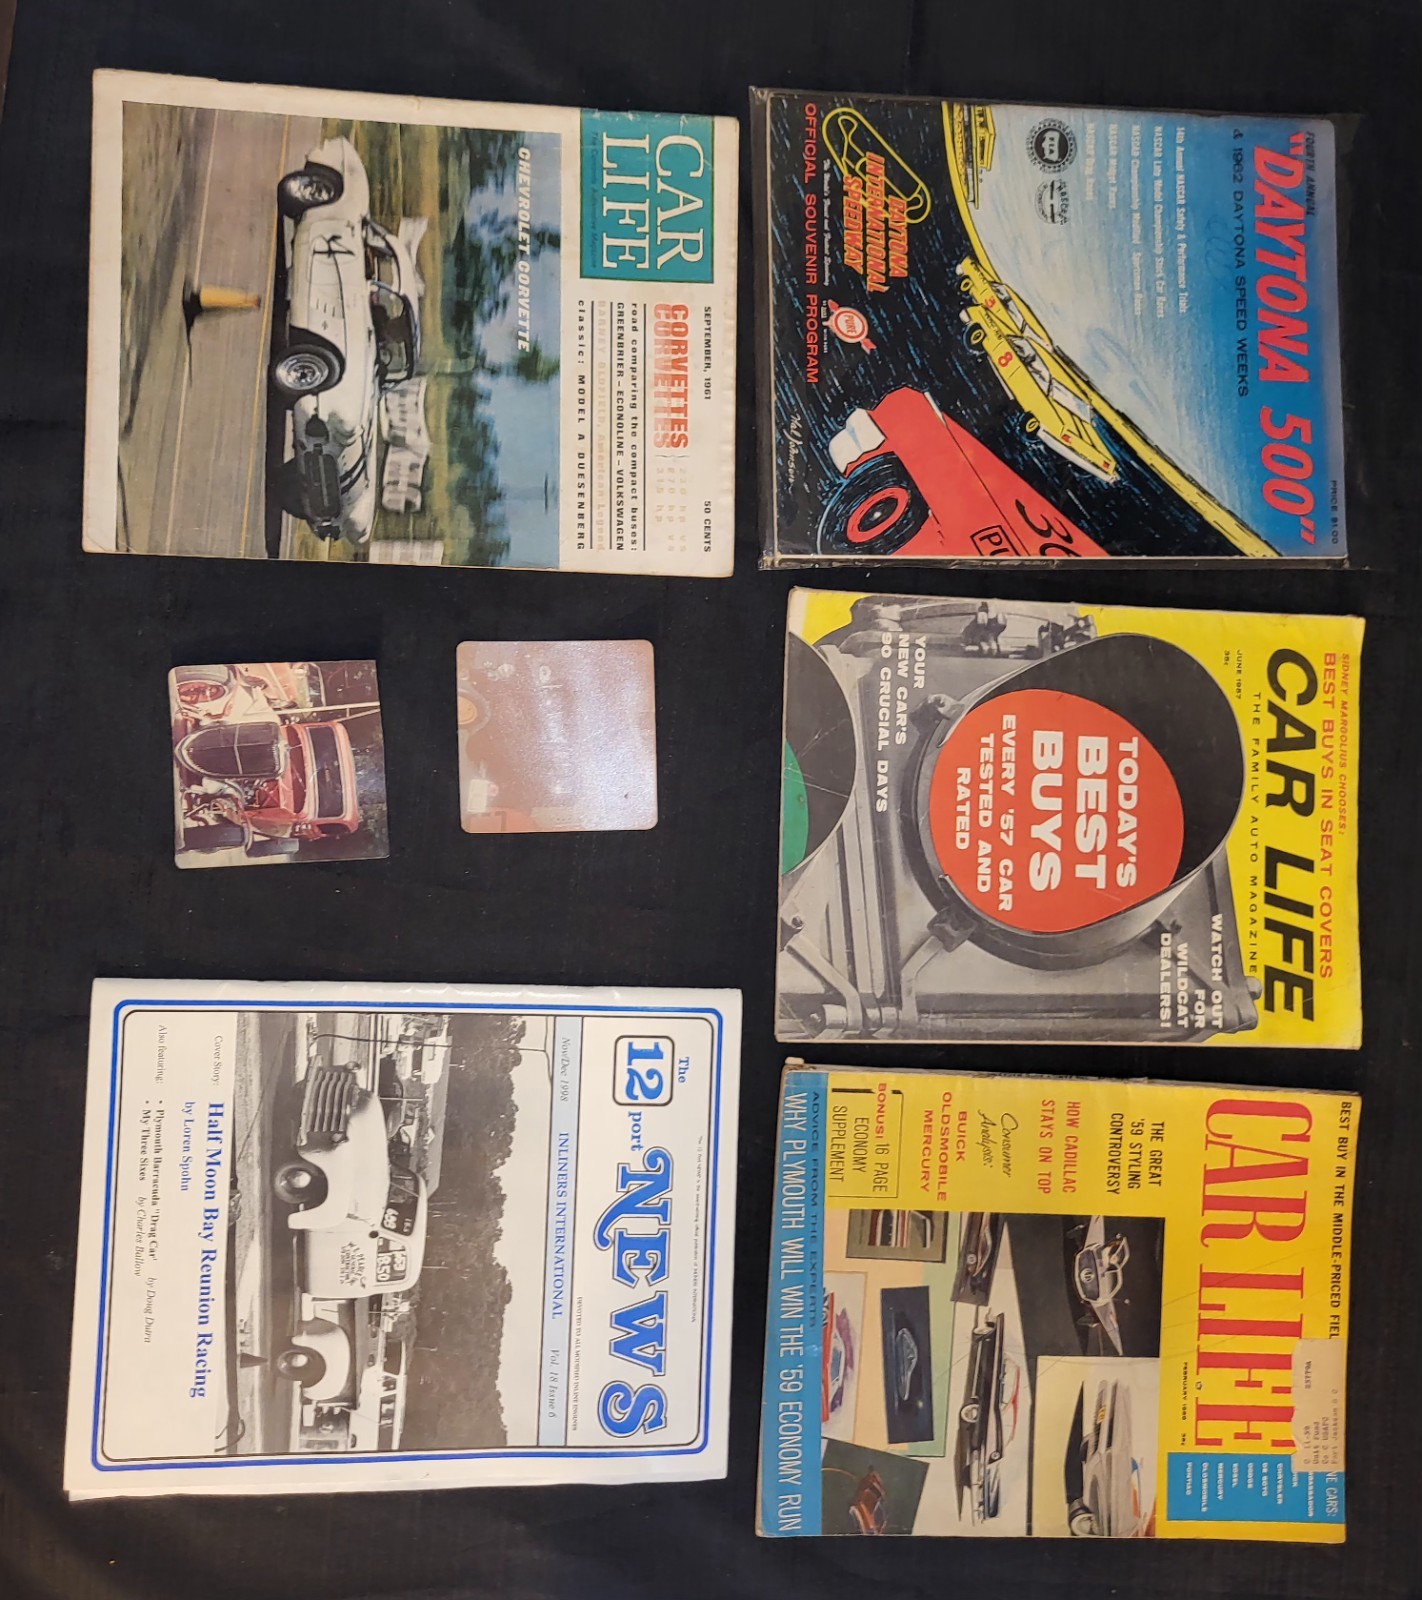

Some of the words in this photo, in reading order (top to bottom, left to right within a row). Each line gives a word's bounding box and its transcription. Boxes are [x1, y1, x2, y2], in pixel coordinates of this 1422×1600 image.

[804, 103, 818, 184] OFFICIAL
[1176, 126, 1185, 143] 14th
[1233, 128, 1243, 140] &
[1304, 132, 1316, 171] FOURTH
[1176, 146, 1185, 171] Annual
[1232, 147, 1244, 184] 1962
[517, 148, 530, 254] CHEVROLET
[602, 132, 650, 268] LIFE
[656, 134, 704, 268] CAR
[1176, 174, 1186, 204] NASCAR
[1306, 176, 1316, 216] ANNUAL
[804, 194, 818, 285] SOUVENIR
[842, 175, 864, 274] SPEEDWAY
[866, 152, 889, 292] INTERNATIONAL
[887, 195, 908, 278] DAYTONA
[1175, 208, 1186, 230] Safety
[1233, 190, 1246, 270] DAYTONA
[1177, 243, 1187, 288] Performance
[1253, 132, 1309, 382] "DAYTONA
[516, 260, 530, 352] CORVETTE
[630, 303, 638, 332] road
[844, 314, 856, 335] PURE
[1234, 276, 1247, 331] SPEED
[578, 300, 586, 364] classic:
[616, 302, 624, 378] GREENBRIER
[703, 306, 712, 372] SEPTEMBER,
[805, 294, 819, 384] PROGRAM
[629, 340, 638, 410] comparing
[670, 304, 689, 449] CORVETTES
[998, 351, 1014, 368] 8
[1236, 338, 1248, 398] WEEKS
[578, 375, 586, 423] MODEL
[704, 378, 712, 400] 1961
[616, 390, 624, 456] ECONOLINE
[630, 416, 638, 437] the
[630, 444, 638, 500] compact
[1260, 406, 1316, 545] 500"
[577, 452, 586, 550] DUESENBERG
[616, 469, 624, 550] VOLKSWAGEN
[704, 501, 712, 514] 50
[630, 508, 639, 552] buses:
[704, 518, 712, 552] CENTS
[880, 632, 893, 658] 90
[896, 634, 910, 677] NEW
[912, 636, 926, 689] YOUR
[1322, 652, 1336, 710] BEST
[1340, 653, 1350, 696] SIDNEY
[877, 667, 892, 751] CRUCIAL
[895, 686, 910, 745] CAR'S
[1252, 692, 1262, 725] THE
[1000, 714, 1016, 796] EVERY
[1265, 648, 1319, 818] CAR
[1320, 719, 1335, 779] BUYS
[1338, 700, 1348, 768] MARGOLIUS
[876, 760, 890, 812] DAYS
[978, 733, 995, 828] TESTED
[1250, 737, 1260, 804] FAMILY
[955, 766, 971, 850] RATED
[1029, 729, 1064, 892] BUYS
[1076, 734, 1109, 890] BEST
[1116, 736, 1140, 888] TODAY'S
[1320, 788, 1334, 808] IN
[1338, 774, 1347, 836] CHOOSES:
[1000, 808, 1015, 846] '57
[1250, 815, 1259, 864] AUTO
[1320, 819, 1334, 876] SEAT
[977, 840, 994, 892] AND
[998, 858, 1014, 912] CAR
[1210, 913, 1222, 982] WATCH
[1248, 876, 1258, 974] MAGAZINE
[1264, 846, 1316, 1022] LIFE
[1319, 886, 1333, 978] COVERS
[1159, 932, 1172, 1028] DEALERS!
[1176, 942, 1189, 1029] WILDCAT
[1194, 988, 1206, 1028] FOR
[1210, 990, 1222, 1028] OUT
[157, 1024, 168, 1043] Also
[212, 1035, 223, 1059] Cover
[558, 1037, 571, 1076] Nov/Dec
[154, 1045, 168, 1084] featuring:
[210, 1062, 222, 1086] Story:
[624, 1041, 664, 1102] 12
[676, 1057, 690, 1084] The
[182, 1102, 195, 1115] by
[560, 1080, 570, 1102] 1998
[784, 1092, 808, 1131] WHY
[875, 1082, 887, 1138] BONUS!
[1064, 1101, 1080, 1128] HOW
[138, 1109, 151, 1124] My
[152, 1109, 166, 1154] Plymouth
[181, 1119, 195, 1152] Loren
[205, 1102, 224, 1144] Half
[628, 1110, 646, 1152] port
[956, 1111, 967, 1162] BUICK
[976, 1110, 995, 1168] Analysis:
[1040, 1100, 1055, 1138] STAYS
[1130, 1118, 1146, 1136] '59
[1148, 1122, 1164, 1142] THE
[1338, 1101, 1352, 1130] BEST
[140, 1127, 151, 1154] Three
[829, 1106, 847, 1182] SUPPLEMENT
[852, 1117, 869, 1172] ECONOMY
[874, 1142, 890, 1155] 16
[920, 1110, 933, 1192] MERCURY
[937, 1092, 952, 1202] OLDSMOBILE
[1000, 1113, 1018, 1178] Consumer
[1038, 1147, 1054, 1163] ON
[1062, 1136, 1078, 1193] CADILLAC
[1106, 1112, 1124, 1194] CONTROVERSY
[1336, 1136, 1349, 1160] BUY
[138, 1158, 150, 1182] Sixes
[150, 1157, 164, 1206] Barracuda
[178, 1156, 194, 1192] Spohn
[203, 1148, 222, 1201] Moon
[554, 1132, 570, 1198] INLINERS
[781, 1140, 806, 1228] PLYMOUTH
[872, 1162, 888, 1192] PAGE
[1038, 1172, 1052, 1194] TOP
[1126, 1142, 1142, 1189] STYLING
[1148, 1150, 1163, 1186] GREAT
[1200, 1100, 1313, 1248] CAR
[1334, 1166, 1347, 1178] IN
[134, 1196, 147, 1207] by
[1333, 1184, 1346, 1208] THE
[136, 1209, 147, 1243] Charles
[198, 1208, 220, 1242] Bay
[134, 1246, 146, 1276] Ballow
[144, 1277, 158, 1288] by
[551, 1202, 568, 1320] INTERNATIONAL
[780, 1238, 804, 1280] WILL
[1330, 1212, 1344, 1309] MIDDLE-PRICED
[142, 1290, 156, 1316] Doug
[198, 1248, 217, 1326] Reunion
[594, 1146, 674, 1438] NEWS
[780, 1285, 804, 1320] WIN
[780, 1325, 803, 1357] THE
[1328, 1314, 1342, 1339] FIEL
[190, 1332, 214, 1398] Racing
[548, 1372, 559, 1382] 18
[549, 1350, 560, 1368] Vol.
[779, 1364, 803, 1392] '59
[1194, 1264, 1306, 1448] LIFE
[548, 1386, 558, 1410] Issue
[778, 1402, 803, 1484] ECONOMY
[778, 1494, 803, 1530] RUN
[1326, 1488, 1338, 1516] CARS:
